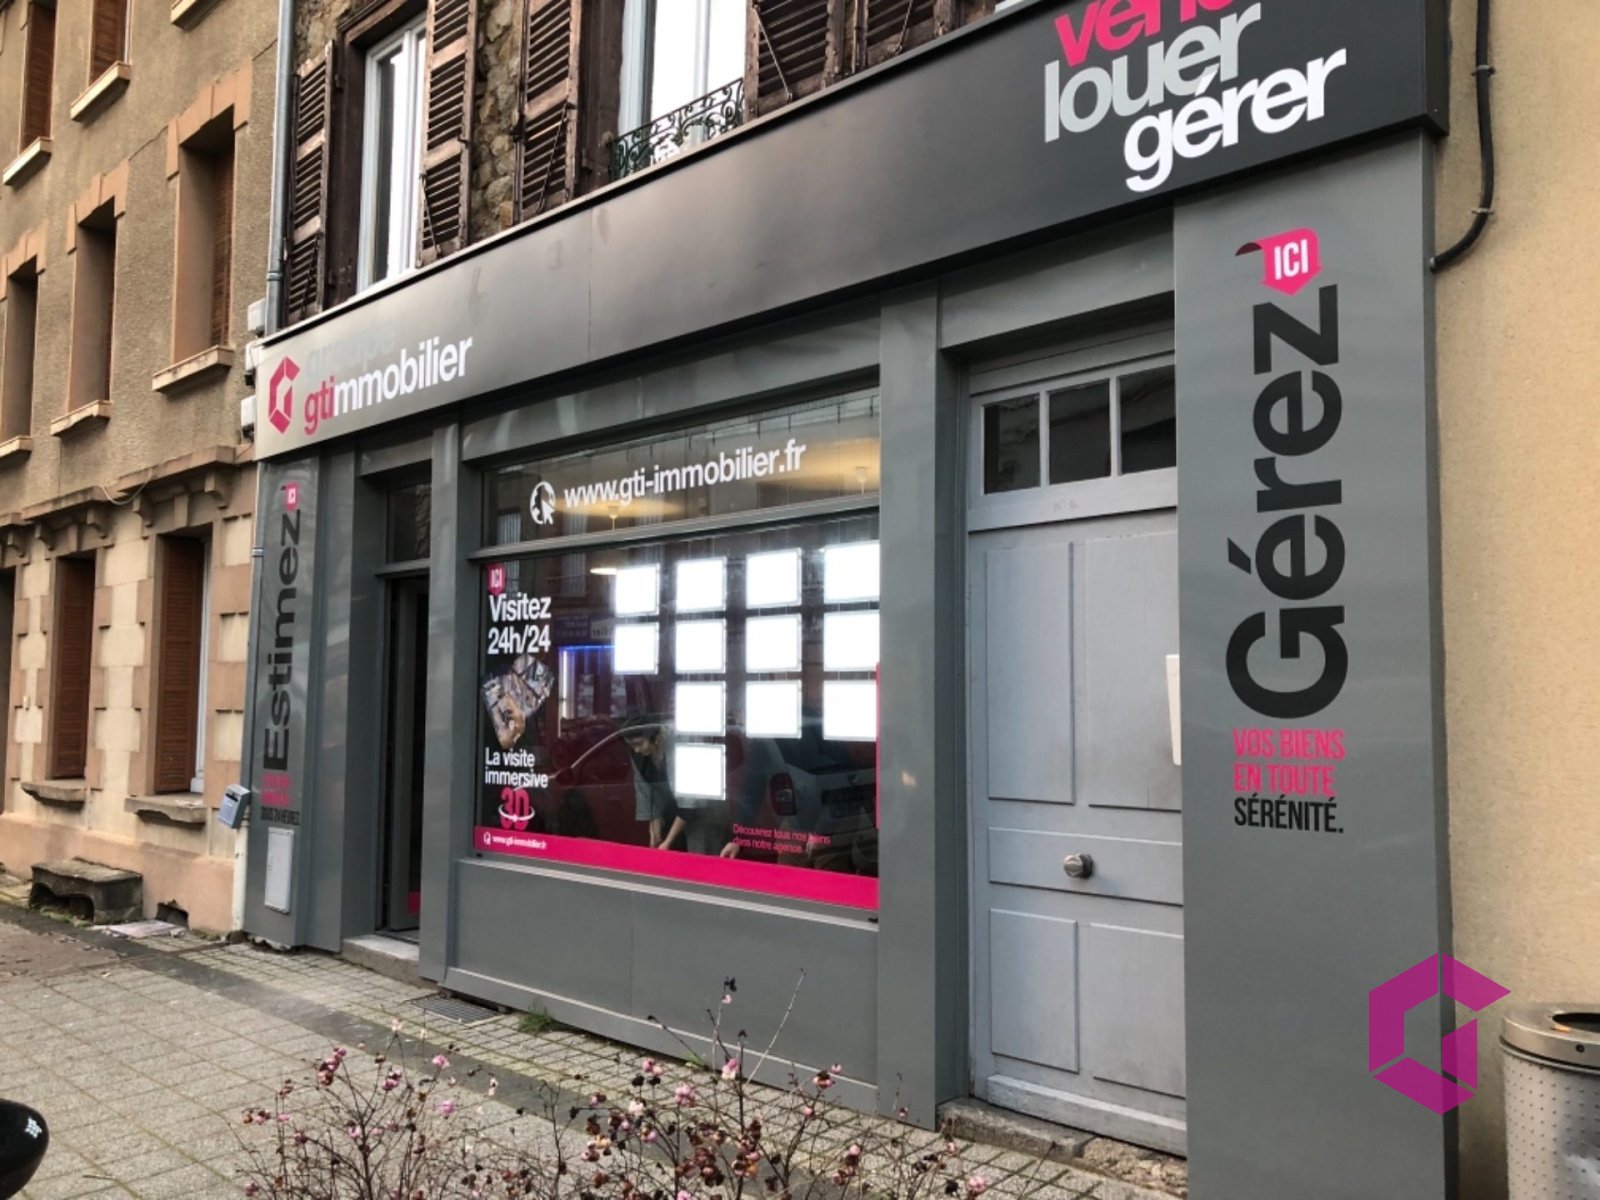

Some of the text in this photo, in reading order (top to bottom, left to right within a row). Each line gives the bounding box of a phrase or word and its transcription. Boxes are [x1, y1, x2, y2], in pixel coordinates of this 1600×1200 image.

[1044, 2, 1262, 143] louer
[1123, 47, 1347, 192] gérer
[1273, 239, 1309, 280] ICI
[303, 336, 473, 436] gtimmobilier
[564, 438, 807, 508] www.gti-immobilier.fr
[1226, 284, 1349, 719] Gérez
[488, 591, 552, 622] Visitez
[263, 508, 302, 771] Estimez
[487, 624, 551, 655] 24h/24
[485, 747, 536, 768] La visite
[1232, 728, 1346, 762] VOS BIENS
[484, 766, 549, 789] immersive
[1232, 762, 1337, 797] EN TOUTE
[1233, 793, 1345, 834] SÉRÉNITÉ.
